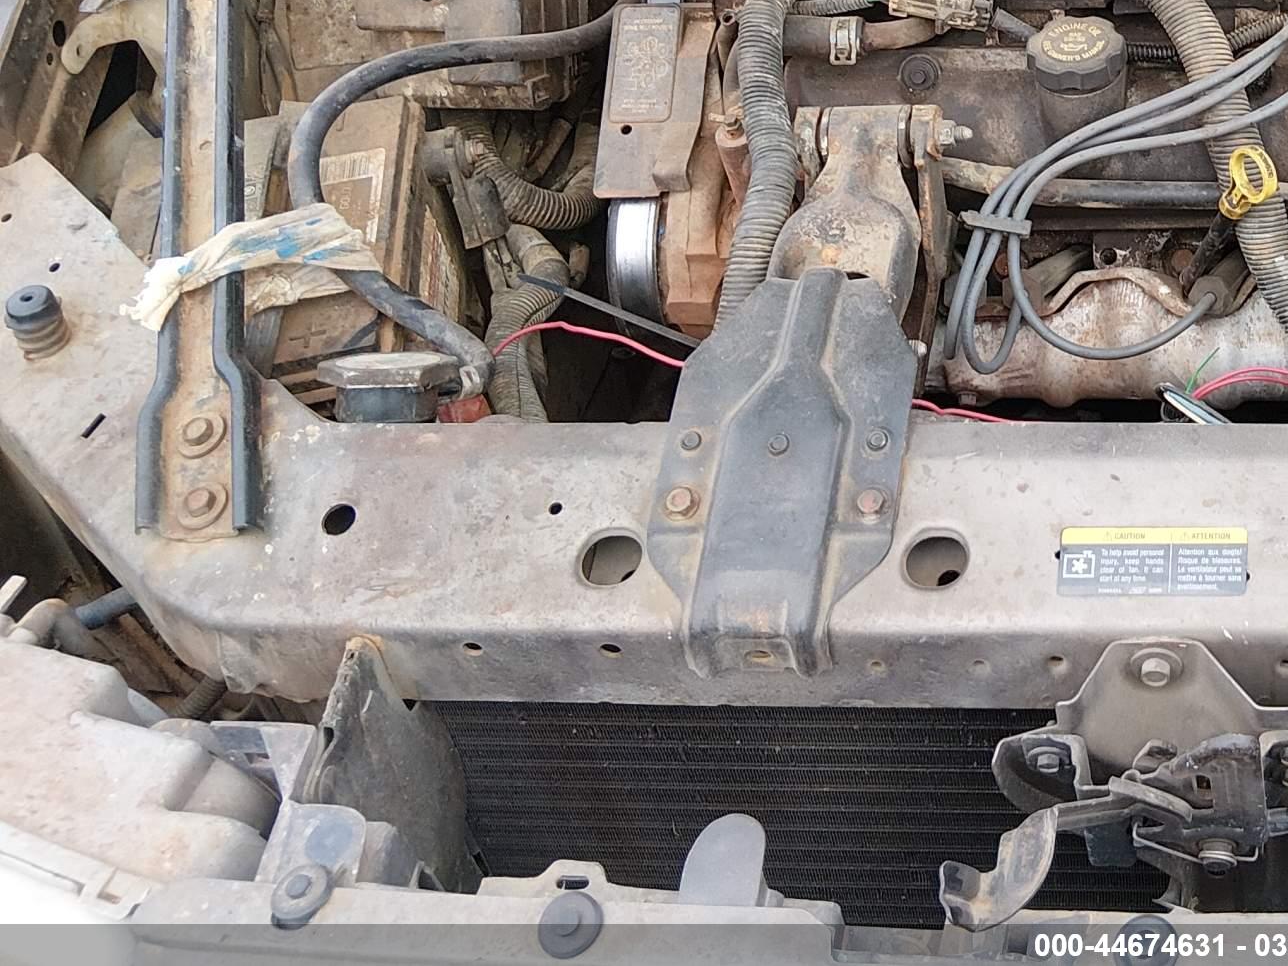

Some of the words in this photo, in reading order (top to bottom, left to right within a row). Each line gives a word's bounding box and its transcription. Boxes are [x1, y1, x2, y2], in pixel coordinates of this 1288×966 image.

[1048, 22, 1088, 37] ENGINE
[1114, 532, 1146, 540] CAUTION
[1191, 532, 1231, 540] ATTENTION
[1139, 549, 1165, 558] personal
[1178, 547, 1205, 555] Attention
[1145, 557, 1164, 565] hands
